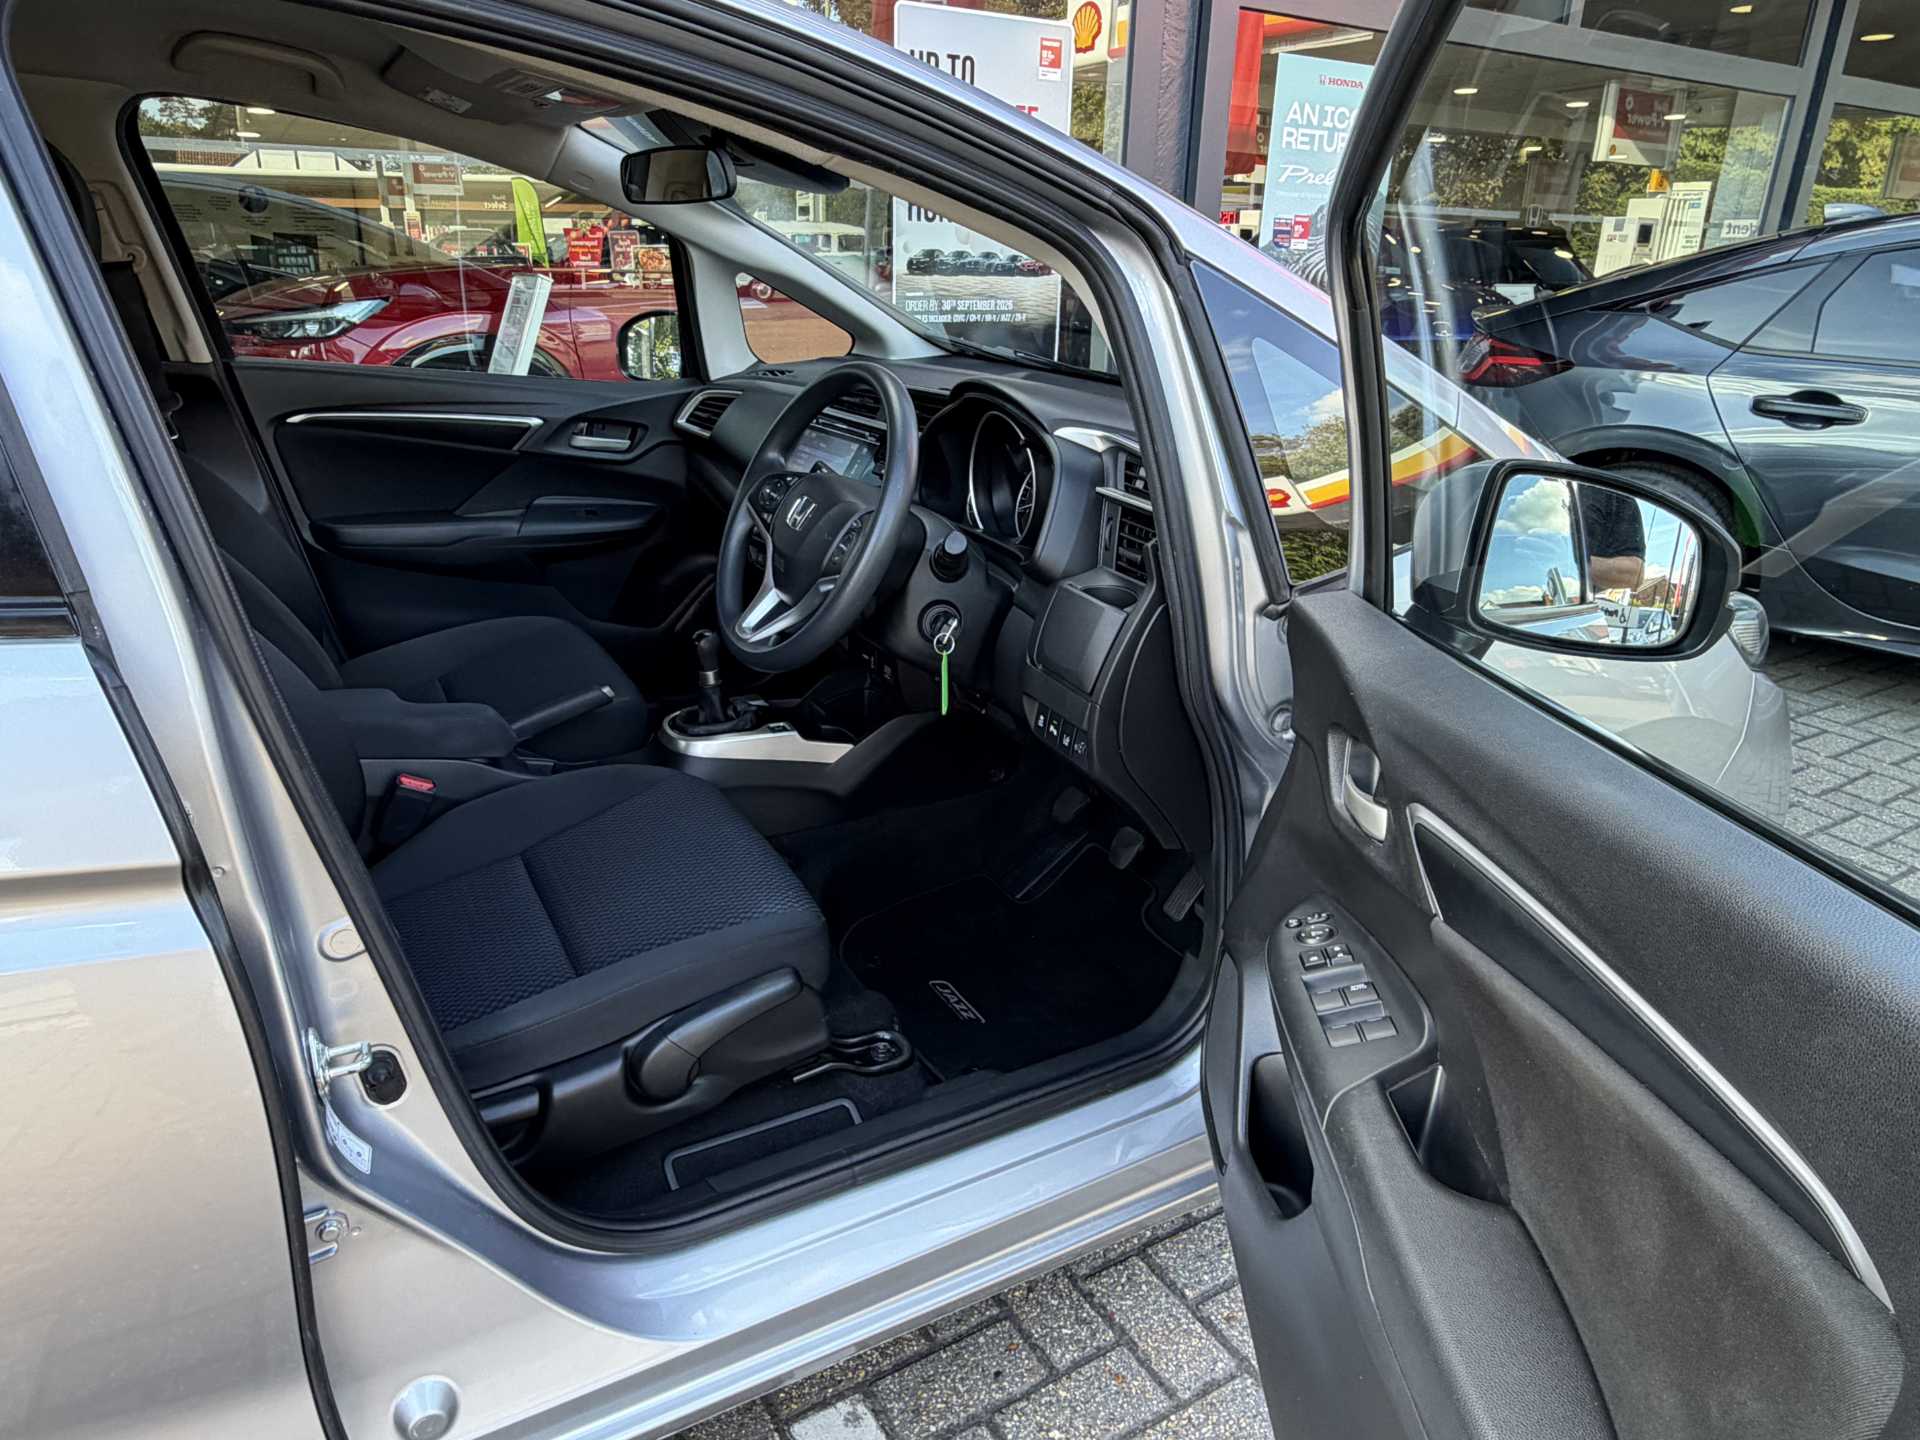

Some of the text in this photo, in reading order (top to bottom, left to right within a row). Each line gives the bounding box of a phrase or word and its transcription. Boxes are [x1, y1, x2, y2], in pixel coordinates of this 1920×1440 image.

[947, 53, 975, 86] TO
[1328, 77, 1364, 89] HONDA
[1285, 100, 1320, 126] AN
[905, 299, 928, 311] ORDER
[957, 299, 995, 311] SEPTEMBER
